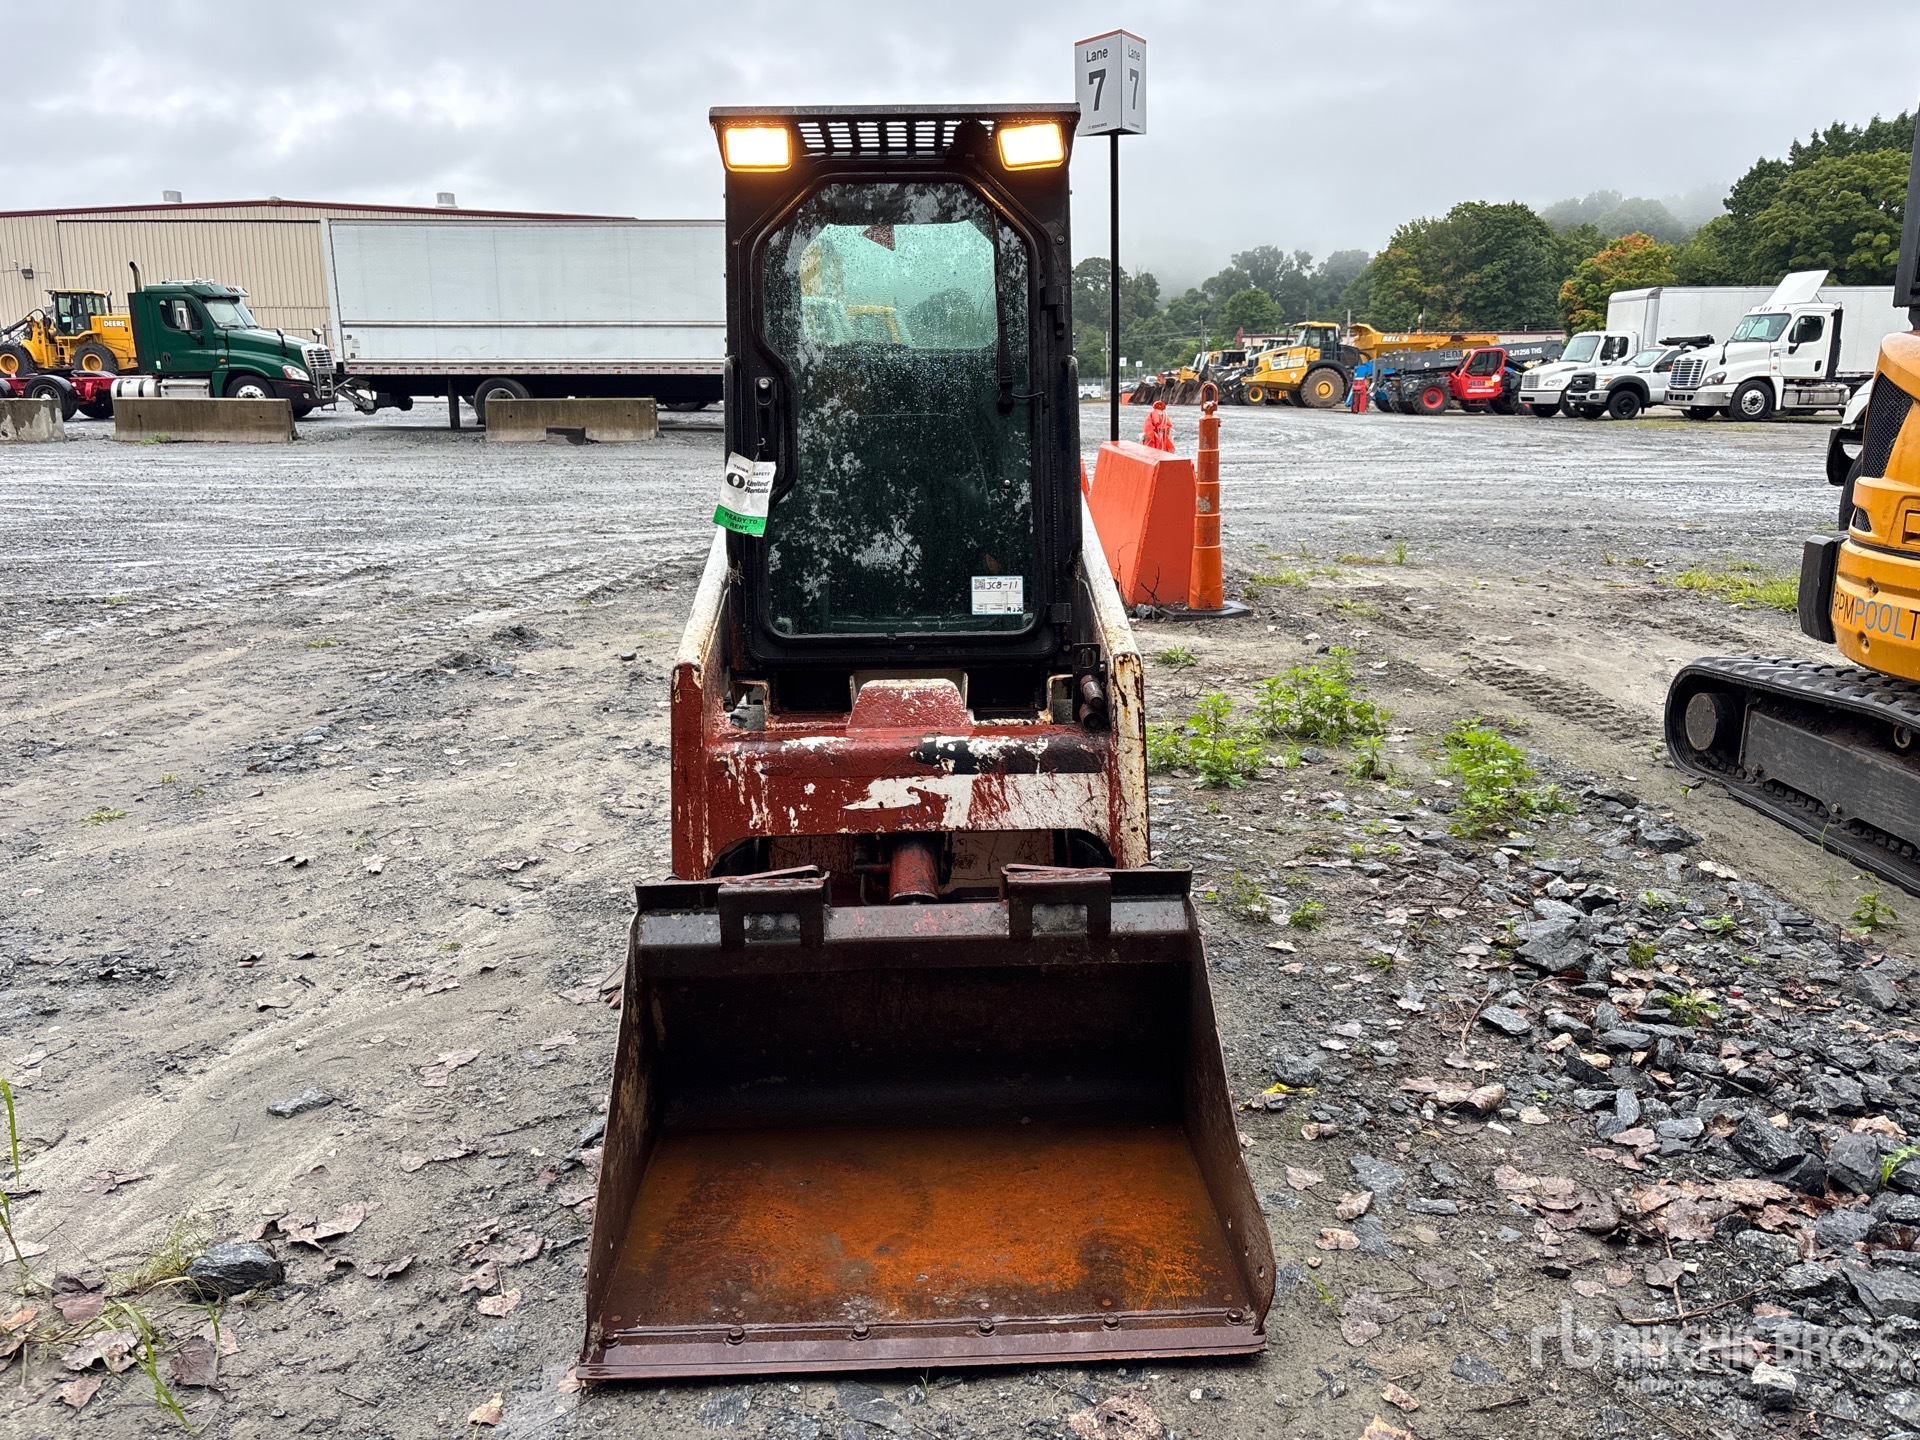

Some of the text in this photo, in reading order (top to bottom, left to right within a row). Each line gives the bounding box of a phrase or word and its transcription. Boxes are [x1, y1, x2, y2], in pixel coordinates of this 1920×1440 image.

[1086, 48, 1108, 63] Lane
[1128, 45, 1140, 61] Lane
[1088, 68, 1106, 111] 7
[1129, 68, 1139, 110] 7
[733, 464, 749, 474] THINK
[746, 479, 770, 487] United
[724, 511, 747, 524] READY
[729, 521, 749, 531] RENT
